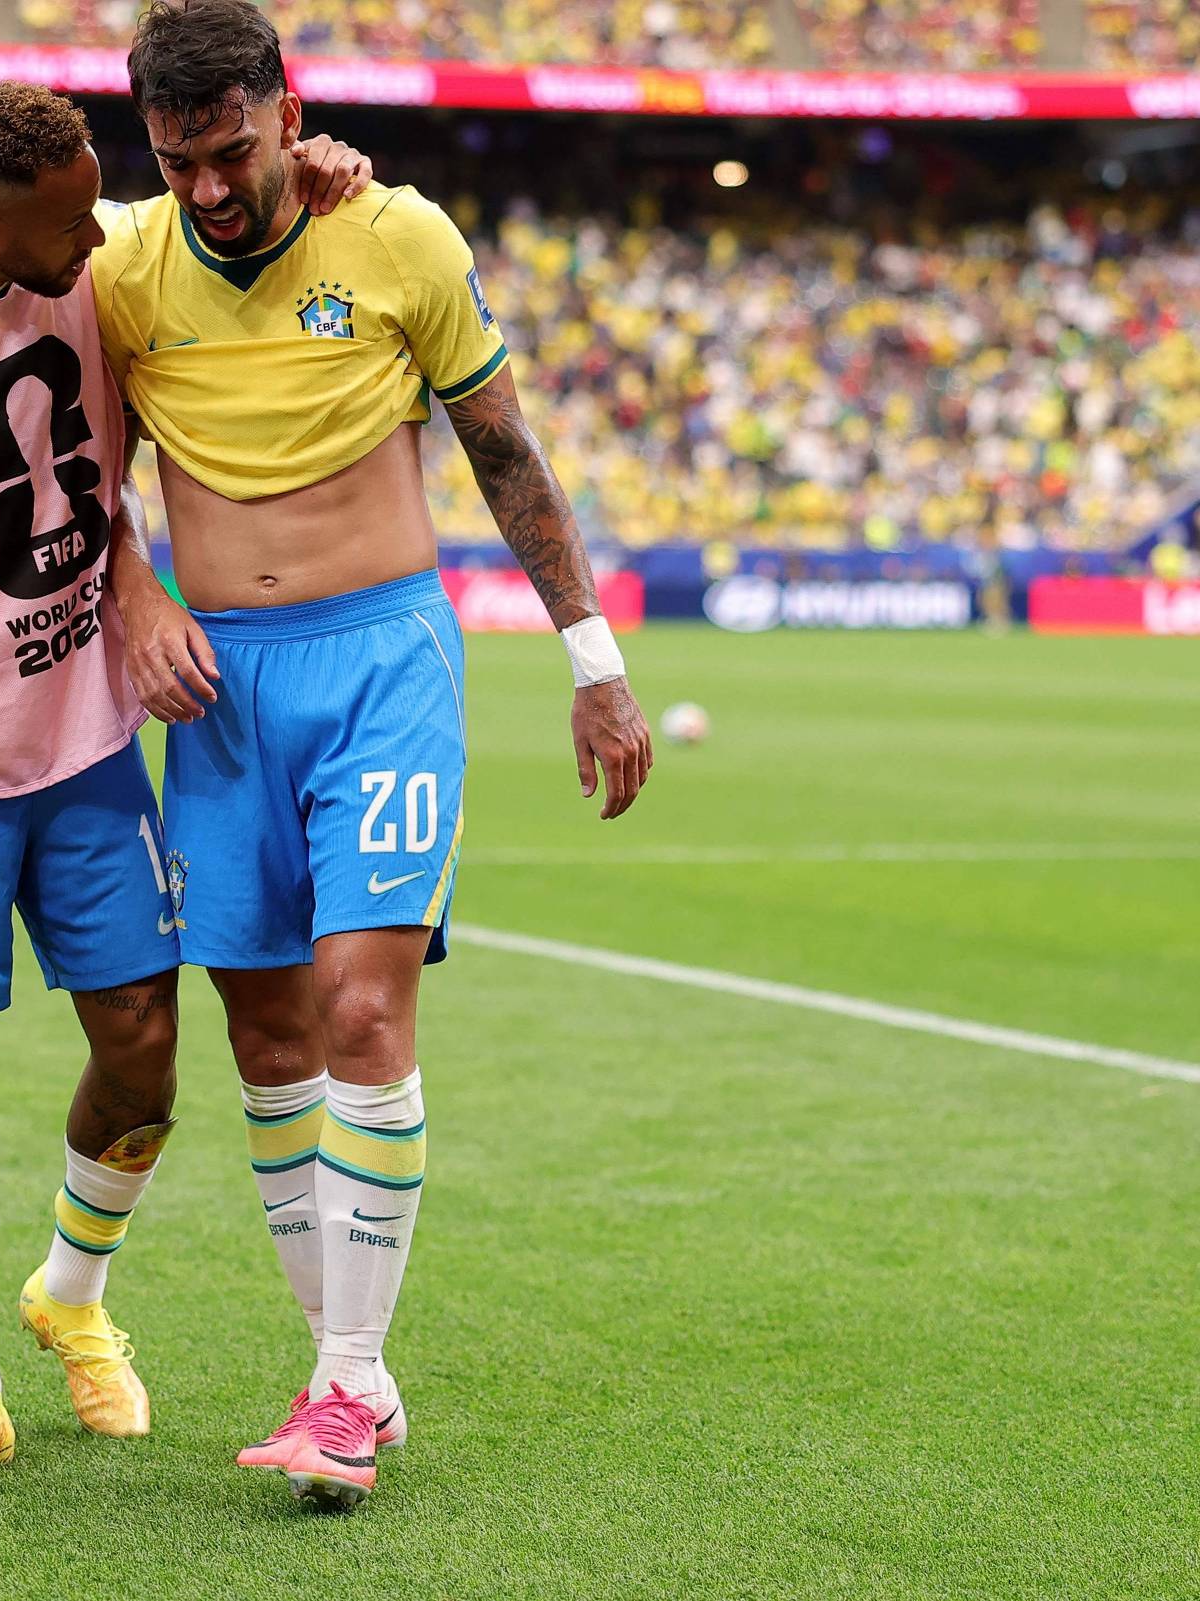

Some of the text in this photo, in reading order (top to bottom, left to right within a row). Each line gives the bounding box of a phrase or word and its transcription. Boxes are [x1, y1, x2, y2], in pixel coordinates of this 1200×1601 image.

[316, 321, 337, 333] CBF
[32, 530, 86, 573] FIFA
[5, 571, 105, 639] WORLD CU
[359, 769, 439, 854] 20
[138, 812, 168, 894] 1
[269, 1220, 316, 1237] BRASIL
[348, 1228, 400, 1249] BRASIL
